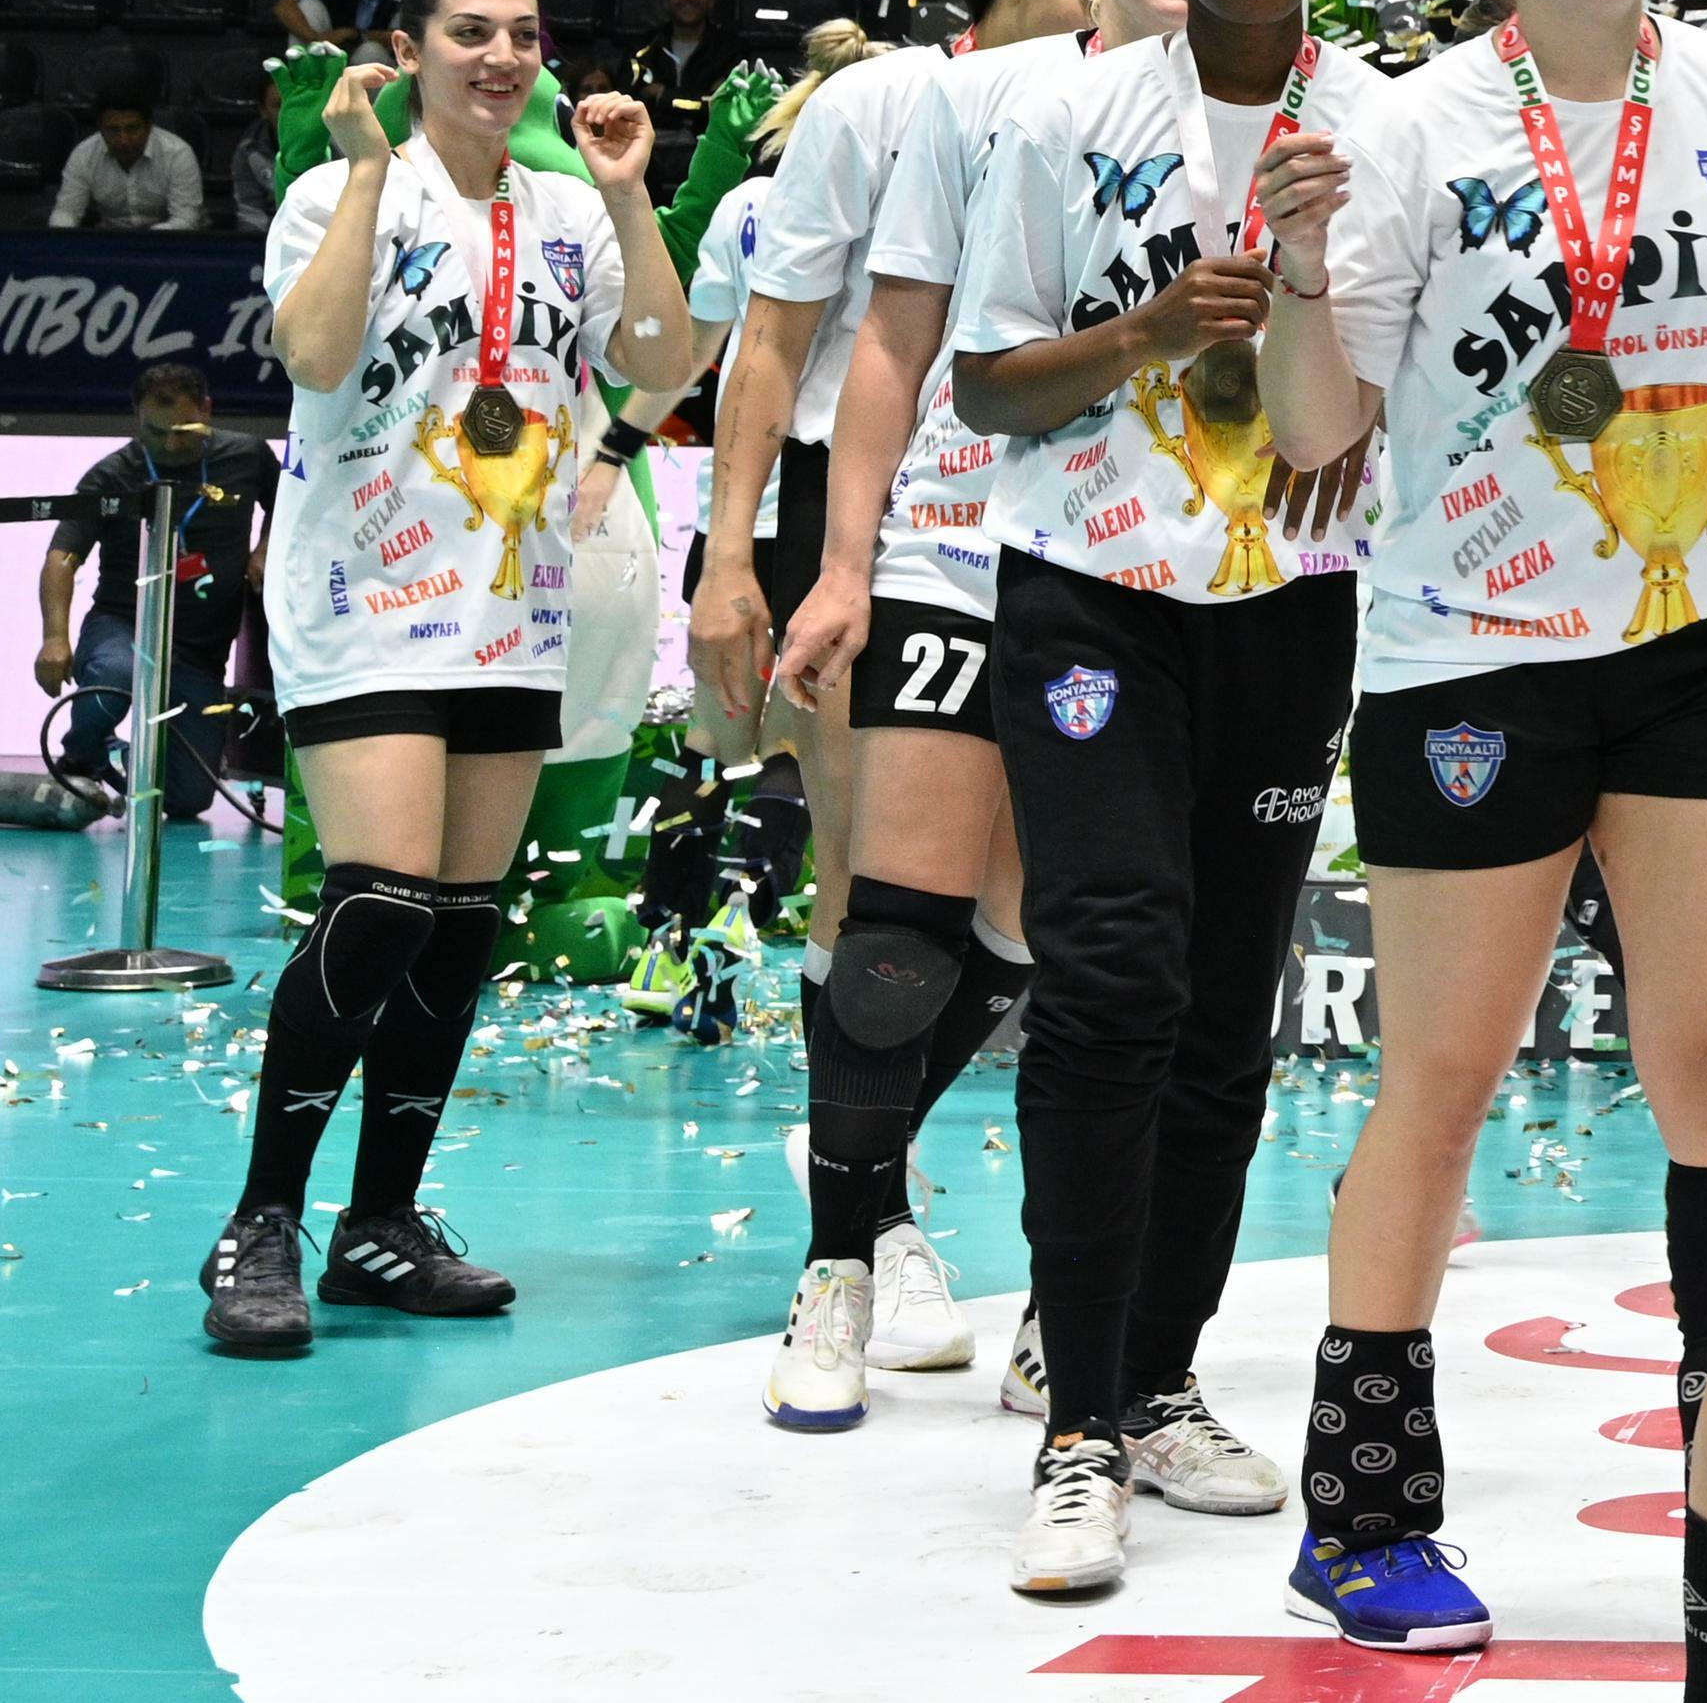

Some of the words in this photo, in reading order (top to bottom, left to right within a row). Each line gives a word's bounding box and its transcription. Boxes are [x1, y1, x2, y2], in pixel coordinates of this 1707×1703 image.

[0, 273, 195, 359] TBOL
[351, 390, 430, 443] SEVİLAY
[939, 440, 993, 479] ALENA
[352, 469, 393, 511] IVANA
[1063, 456, 1120, 526] CEYLAN
[1441, 473, 1502, 522] IVANA
[353, 486, 406, 551] CEYLAN
[379, 520, 433, 567] ALENA
[1083, 496, 1146, 547] ALENA
[1453, 496, 1524, 579] CEYLAN
[364, 569, 463, 614] VALERIIA
[1485, 540, 1556, 599] ALENA
[894, 632, 987, 715] 27
[1047, 678, 1116, 703] KONYAALTI
[1430, 741, 1500, 756] KONYAALTI
